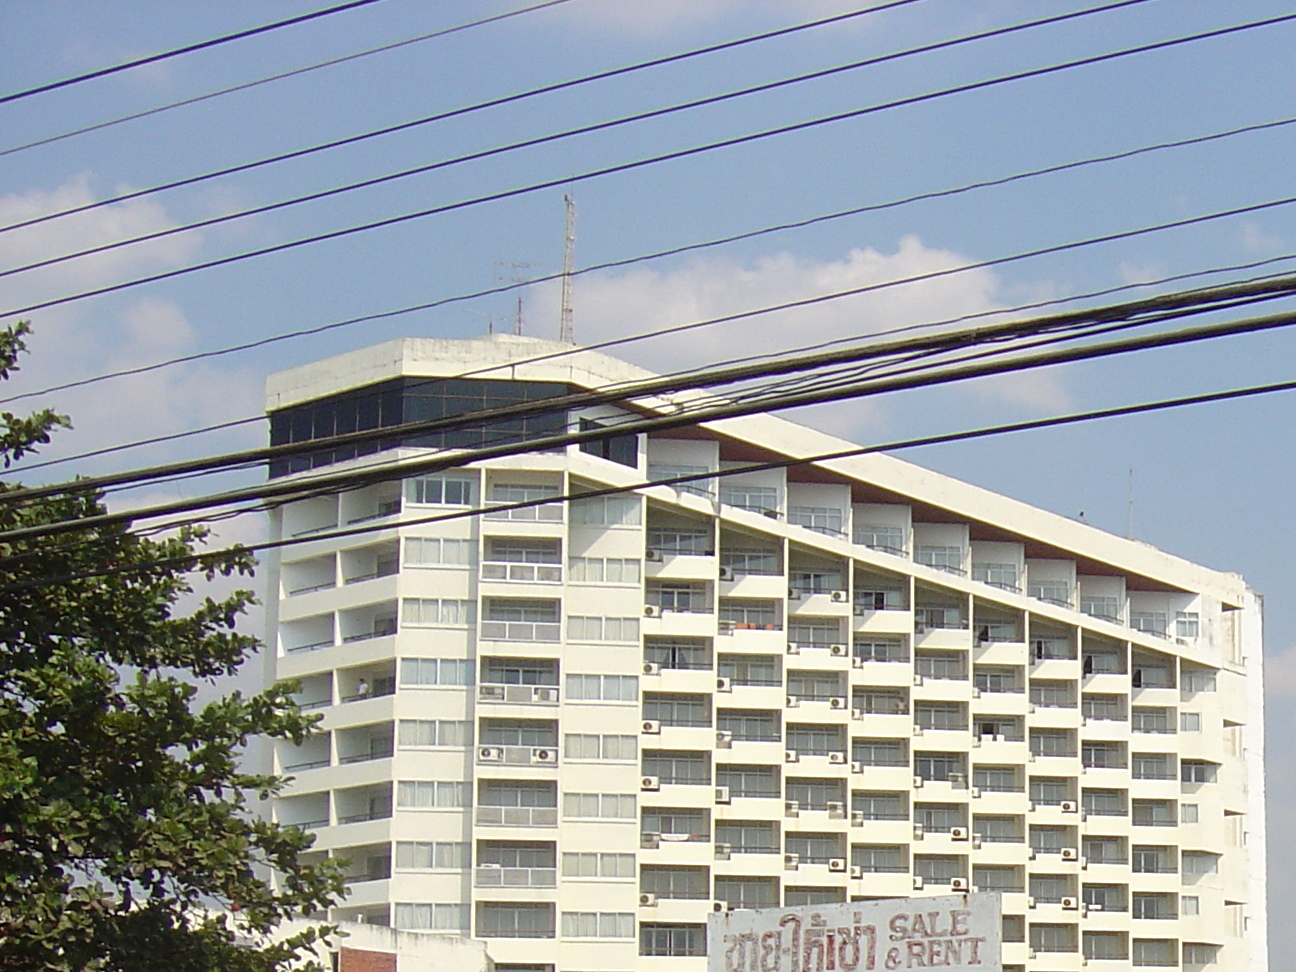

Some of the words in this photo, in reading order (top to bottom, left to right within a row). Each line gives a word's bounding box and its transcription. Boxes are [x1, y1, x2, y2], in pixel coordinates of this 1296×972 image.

[889, 909, 971, 941] SALE
[885, 947, 902, 970] &
[906, 936, 987, 968] RENT
